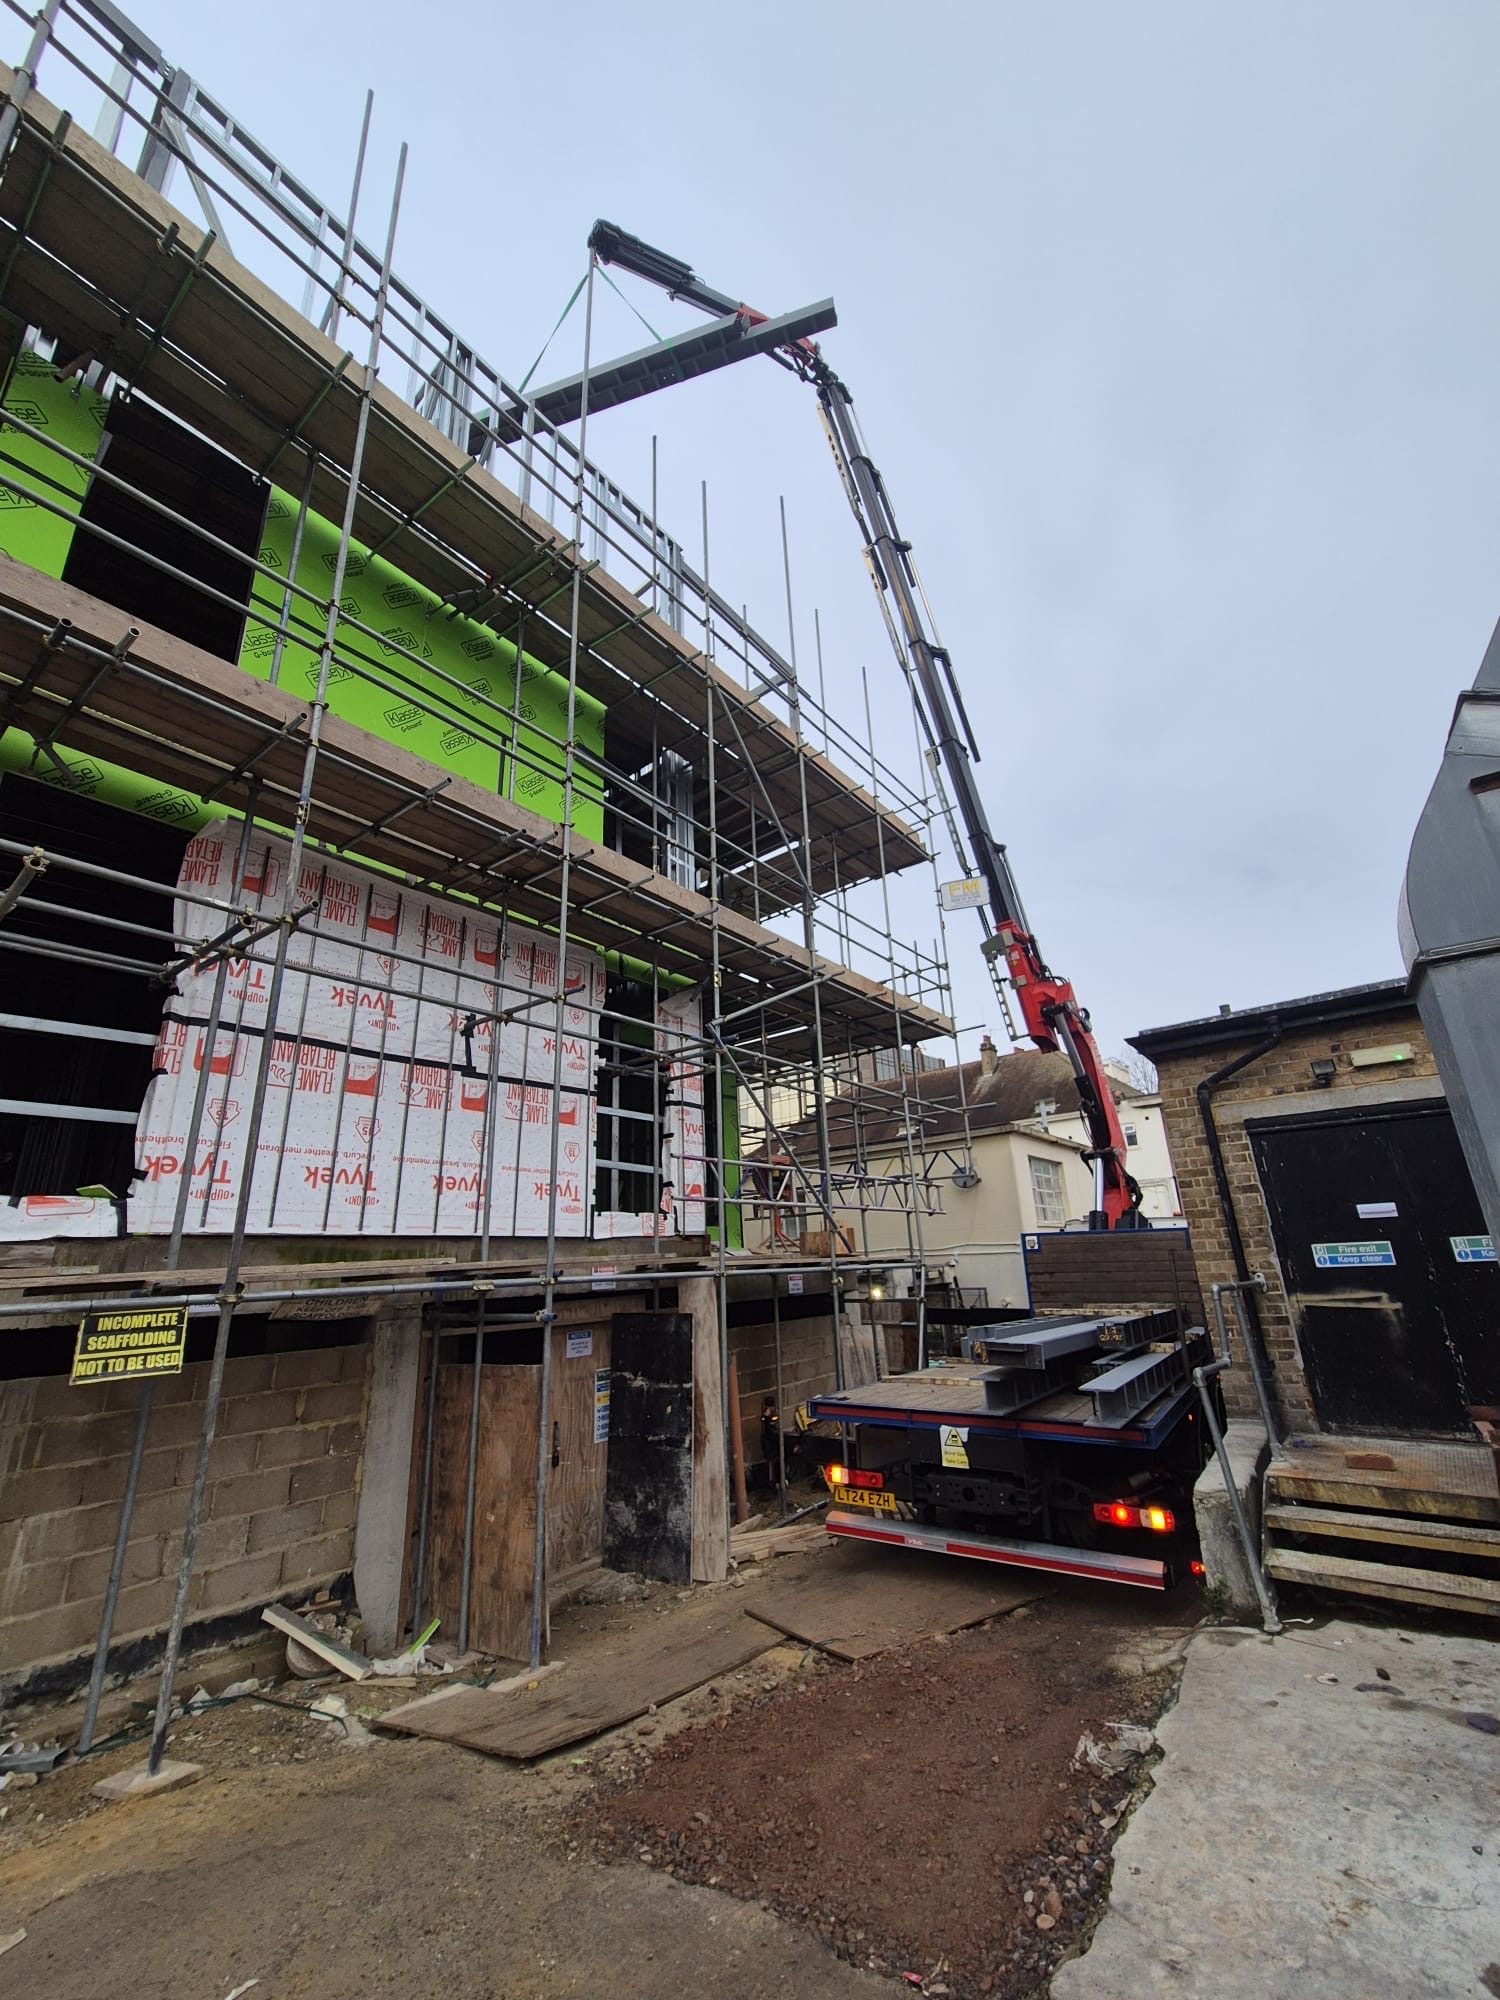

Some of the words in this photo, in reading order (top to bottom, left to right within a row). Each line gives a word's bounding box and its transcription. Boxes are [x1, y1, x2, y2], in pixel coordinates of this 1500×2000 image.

[387, 707, 421, 725] Klasse
[443, 734, 474, 751] Klasse
[521, 774, 543, 791] Klasse
[135, 789, 173, 806] G-board
[181, 859, 219, 887] FLAME
[299, 868, 360, 902] RETARANT
[322, 899, 358, 927] FLAME
[440, 934, 466, 961] FAME
[516, 943, 557, 969] RETARANT
[533, 967, 556, 987] FLAME
[232, 991, 264, 1004] DUPNT
[331, 985, 397, 1019] Tyvek
[371, 1020, 396, 1031] DUONT
[270, 1039, 337, 1070] RETARANT
[543, 1037, 586, 1060] Tyvek
[296, 1067, 334, 1095] FLAME
[424, 1086, 452, 1112] FAME
[507, 1083, 549, 1104] RETARANT
[523, 1103, 549, 1125] FLAME
[684, 1119, 704, 1139] yve
[304, 1163, 377, 1191] Tyvek
[433, 1172, 488, 1197] Tyvek
[194, 1189, 230, 1201] DUPNT
[348, 1194, 375, 1206] DUONT
[534, 1179, 581, 1202] Tyvek
[1338, 1255, 1360, 1264] Keep
[1360, 1245, 1377, 1253] exit
[97, 1313, 178, 1331] INCOMPLETE
[87, 1330, 176, 1351] SCAFFOLDING
[75, 1360, 106, 1377] NOT
[107, 1357, 125, 1373] TO
[126, 1355, 144, 1371] BE
[145, 1352, 180, 1368] USED
[837, 1487, 865, 1504] LT24
[868, 1493, 890, 1507] EZH
